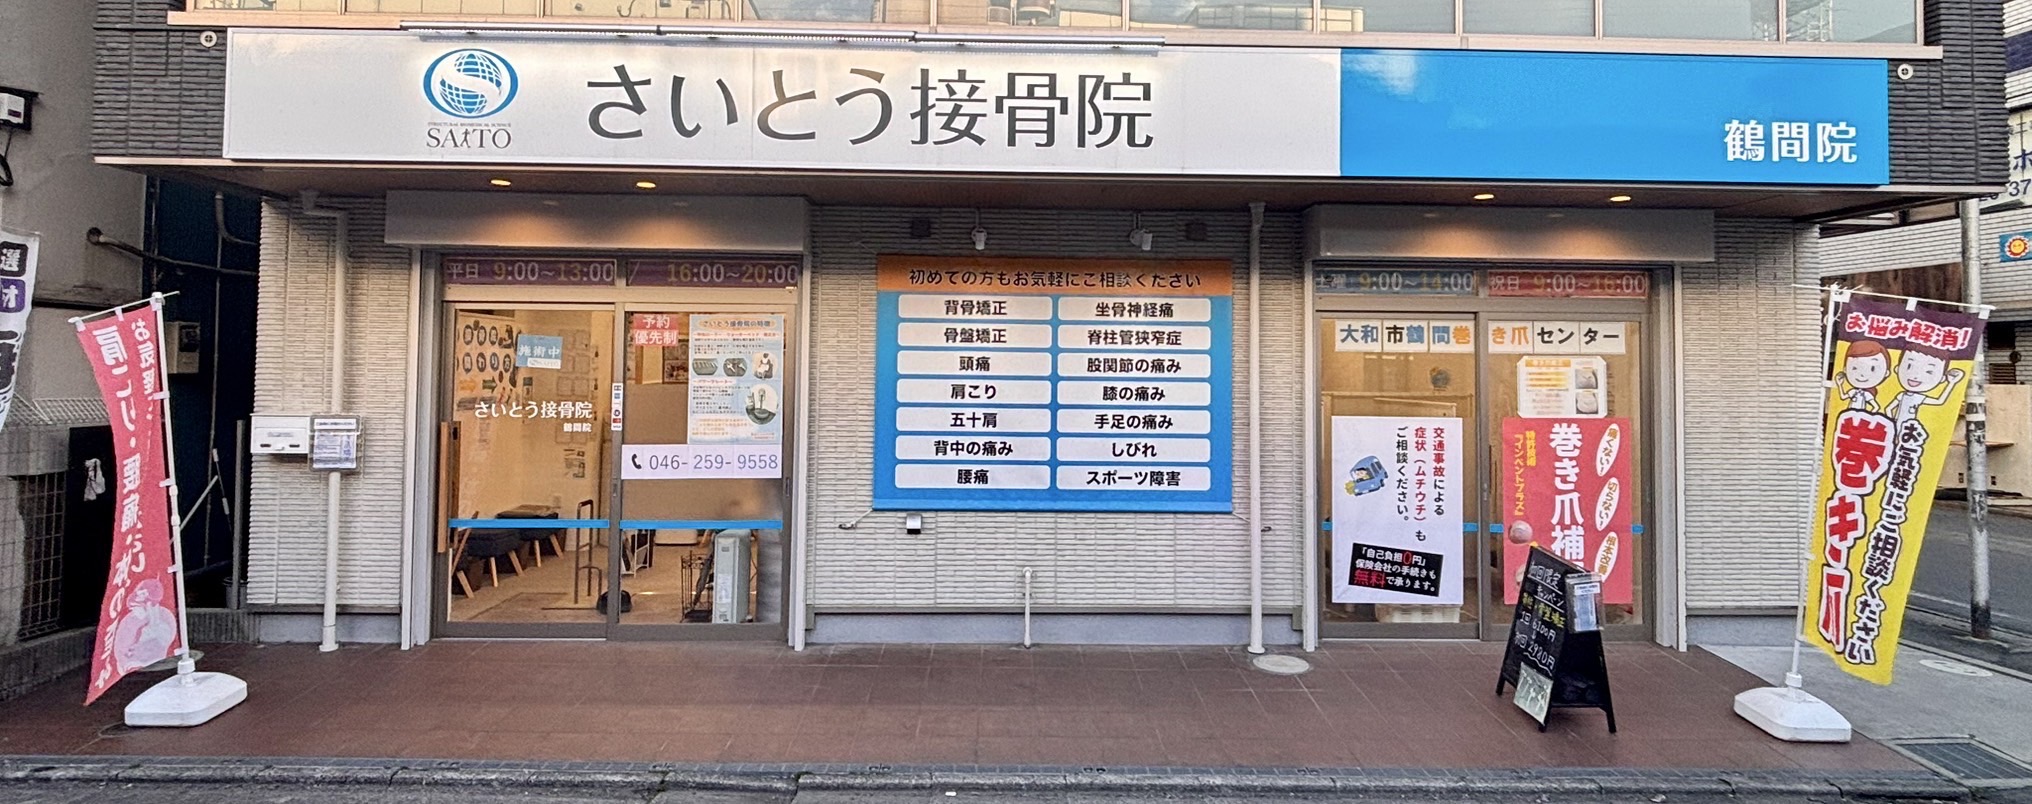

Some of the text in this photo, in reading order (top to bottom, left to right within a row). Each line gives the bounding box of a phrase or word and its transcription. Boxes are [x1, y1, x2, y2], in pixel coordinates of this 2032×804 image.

[586, 64, 1155, 148] さいとう接骨院
[1723, 119, 1857, 163] 鶴間院
[449, 262, 479, 280] 平日
[909, 269, 1201, 289] 初めての方もお気軽にご相談ください
[1490, 275, 1520, 291] 祝日
[944, 300, 1007, 316] 背骨矯正
[1095, 302, 1174, 318] 坐骨神経痛
[643, 315, 670, 329] 予約
[635, 330, 678, 345] 優先制
[944, 328, 1007, 344] 骨盤矯正
[1087, 330, 1182, 346] 脊柱管狭窄症
[1846, 313, 1972, 350] お悩み解消！
[519, 345, 560, 358] 施術中
[959, 356, 991, 371] 頭痛
[1087, 358, 1181, 373] 股関節の痛み
[950, 384, 997, 399] 肩こり
[1102, 386, 1166, 401] 膝の痛み
[475, 401, 593, 418] さいとう接骨院
[950, 413, 997, 428] 五十肩
[1094, 415, 1173, 430] 手足の痛み
[934, 440, 1013, 456] 背中の痛み
[1112, 442, 1157, 458] しびれ
[957, 469, 989, 485] 腰痛
[1086, 470, 1181, 487] スポーツ障害
[1396, 426, 1409, 521] ご相談ください。
[1433, 427, 1445, 516] 交通事故による
[1549, 423, 1585, 571] 巻き爪補
[1821, 415, 1890, 648] 巻き爪
[1850, 422, 1923, 661] お気軽にご相談ください
[1355, 558, 1436, 580] 保険会社の手続きも
[1353, 569, 1436, 592] 無料で承ります。
